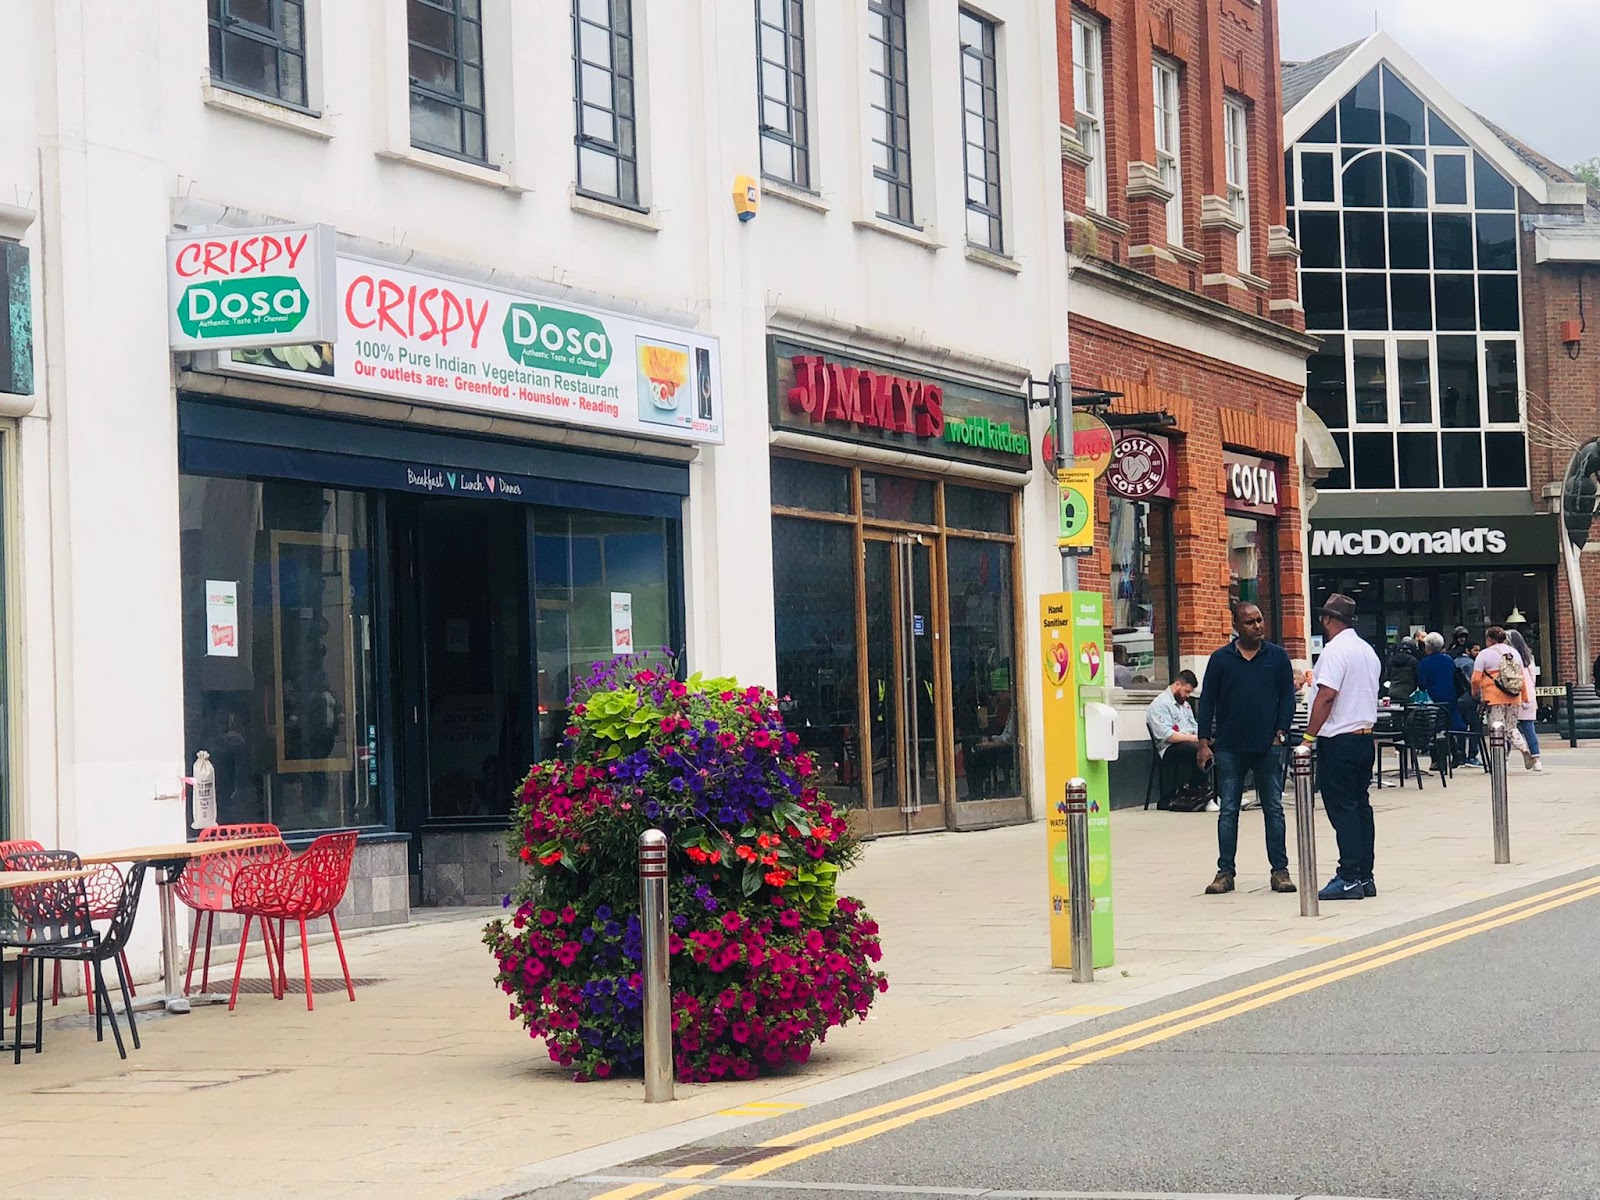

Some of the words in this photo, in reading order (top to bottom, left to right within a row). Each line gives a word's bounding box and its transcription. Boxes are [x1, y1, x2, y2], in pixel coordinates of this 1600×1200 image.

[176, 233, 307, 277] CRISPY
[188, 288, 301, 321] Dosa
[345, 275, 489, 349] CRISPY
[198, 319, 230, 327] Authentic
[232, 317, 251, 325] Taste
[263, 315, 289, 323] Chennai
[512, 307, 607, 360] Dosa
[355, 339, 394, 362] 100%
[399, 347, 431, 367] Pure
[435, 352, 477, 376] Indian
[482, 361, 551, 388] Vegetarian
[554, 374, 619, 399] Restaurant
[522, 348, 549, 359] Authentic
[551, 352, 567, 362] Taste
[568, 356, 575, 364] of
[354, 360, 377, 377] Our
[380, 368, 422, 384] outlets
[425, 374, 448, 388] are:
[454, 376, 509, 398] Greenford
[519, 387, 570, 407] Hounslow
[579, 396, 619, 418] Reading
[788, 355, 945, 438] JIMMY'S
[709, 424, 719, 433] BAR
[944, 416, 988, 447] world
[988, 421, 1029, 455] kitchen
[1114, 440, 1154, 458] COSTA
[407, 467, 445, 491] Breakfast
[461, 473, 485, 491] Lunch
[498, 477, 523, 495] Dinner
[1112, 472, 1160, 493] COFFEE
[1231, 463, 1278, 504] COSTA
[1311, 527, 1507, 556] McDonald's
[1043, 617, 1069, 628] Sanitiser
[1048, 604, 1063, 614] Hand
